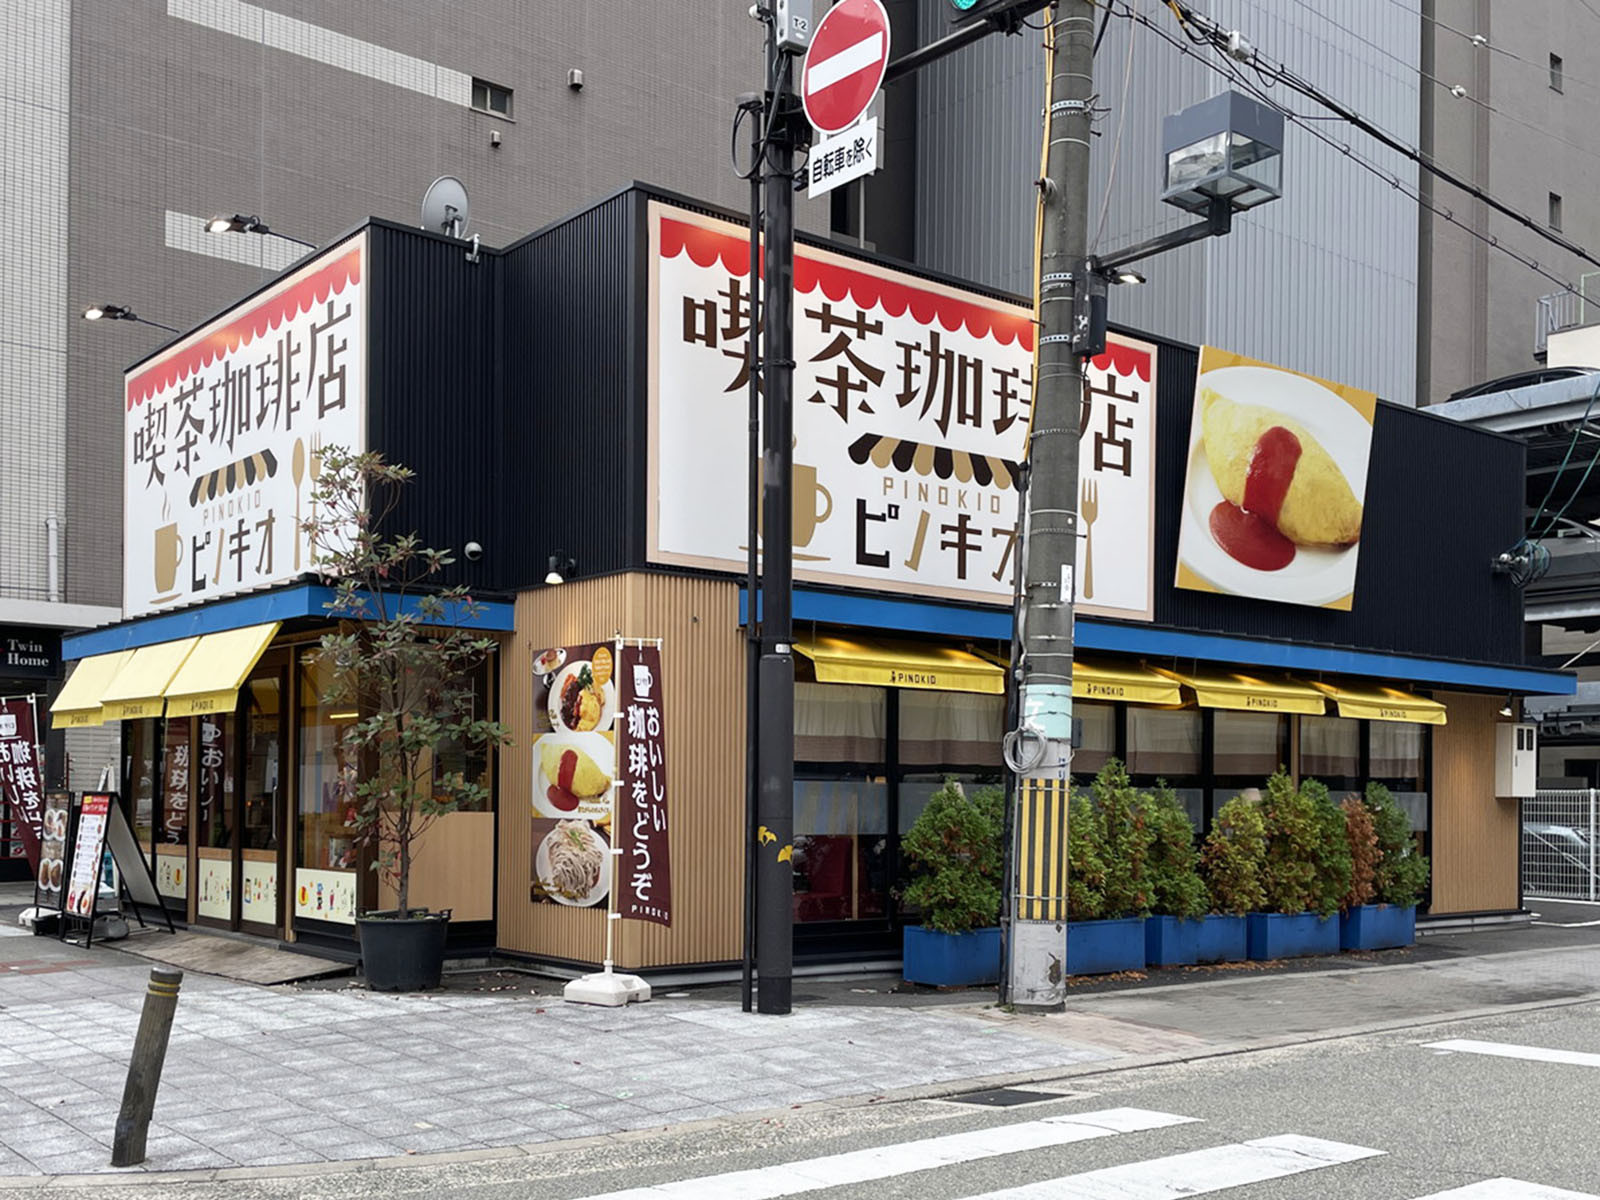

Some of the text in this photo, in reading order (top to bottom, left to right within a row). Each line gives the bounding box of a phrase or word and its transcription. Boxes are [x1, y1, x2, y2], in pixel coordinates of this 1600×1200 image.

[812, 136, 873, 184] 自転車を除く
[133, 299, 352, 490] 喫茶珈琲店
[203, 489, 261, 526] PINOKIO
[883, 476, 1001, 514] PINOKIO
[192, 508, 276, 593] ピノキオ
[7, 638, 43, 653] Twin
[7, 652, 49, 667] Home
[898, 672, 936, 685] PINOKIO
[646, 705, 667, 832] おいしい
[626, 703, 653, 901] 珈琲をどうぞ
